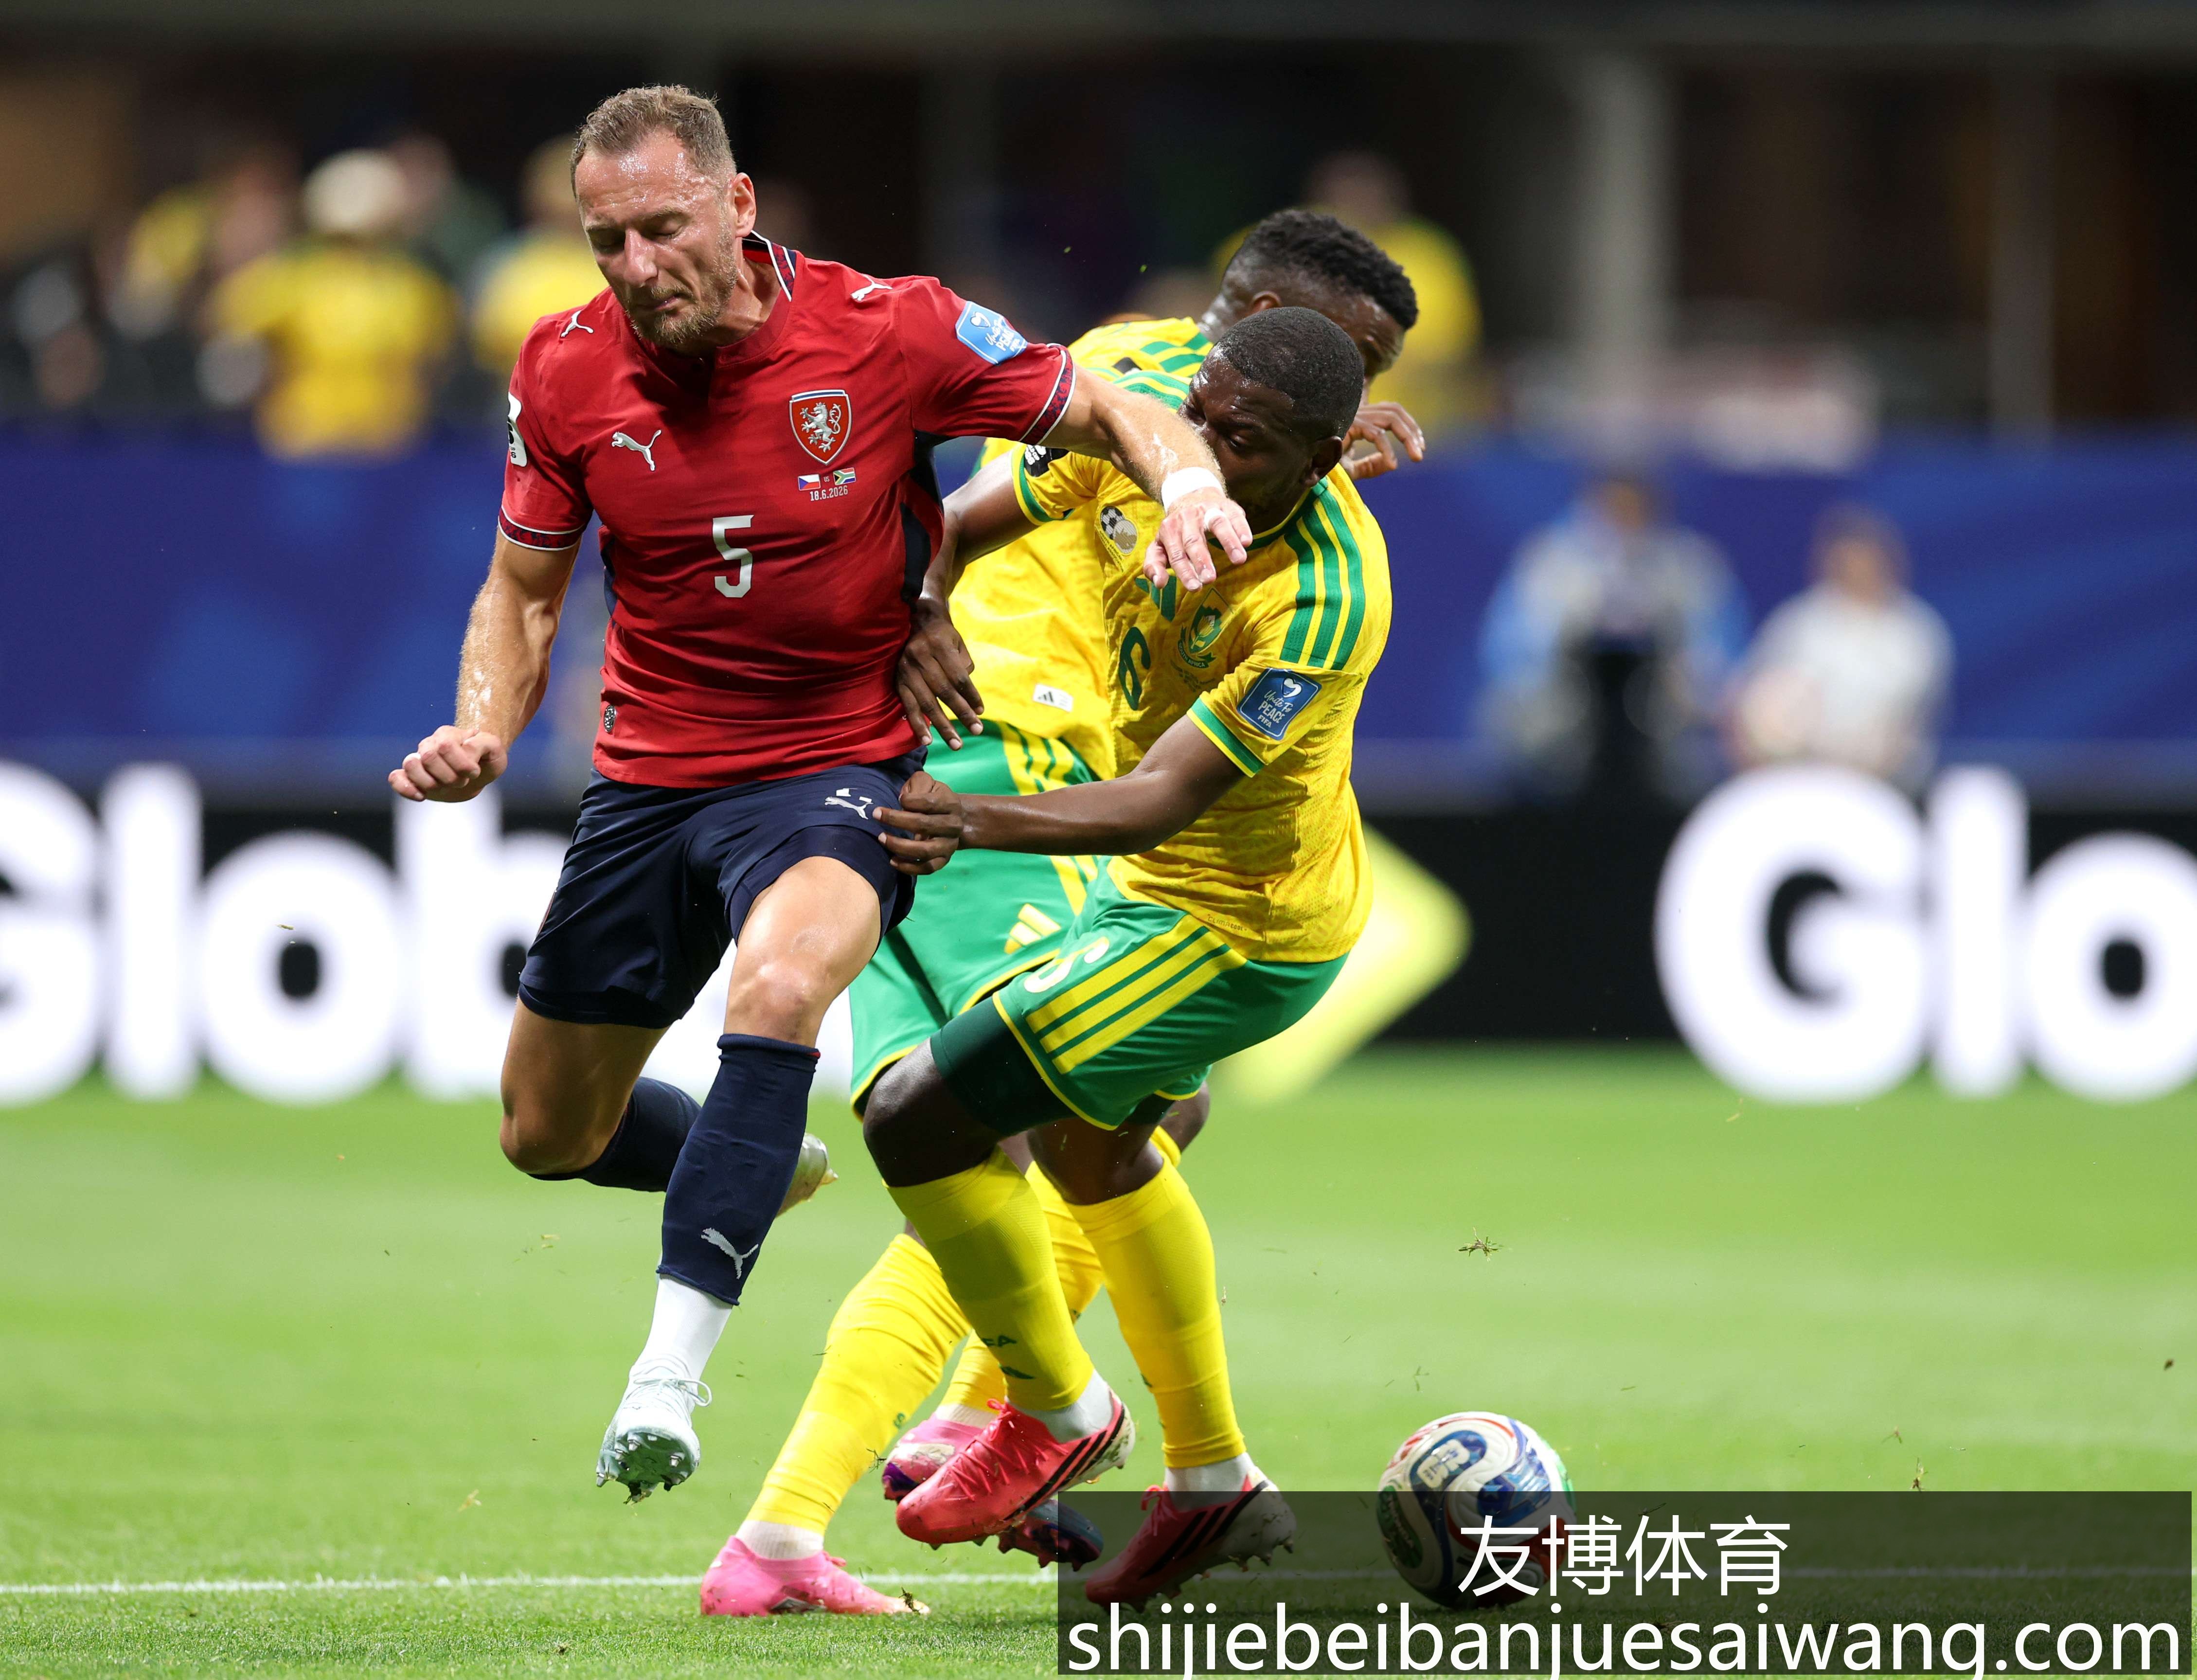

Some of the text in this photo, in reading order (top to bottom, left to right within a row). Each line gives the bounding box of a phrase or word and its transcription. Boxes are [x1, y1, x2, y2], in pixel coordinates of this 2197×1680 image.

[809, 485, 848, 501] 18.6.2026
[712, 515, 754, 598] 5
[1264, 690, 1284, 707] Unite
[1257, 715, 1272, 728] FIFA
[1258, 700, 1286, 724] PEACE
[1654, 763, 2197, 1105] Glo
